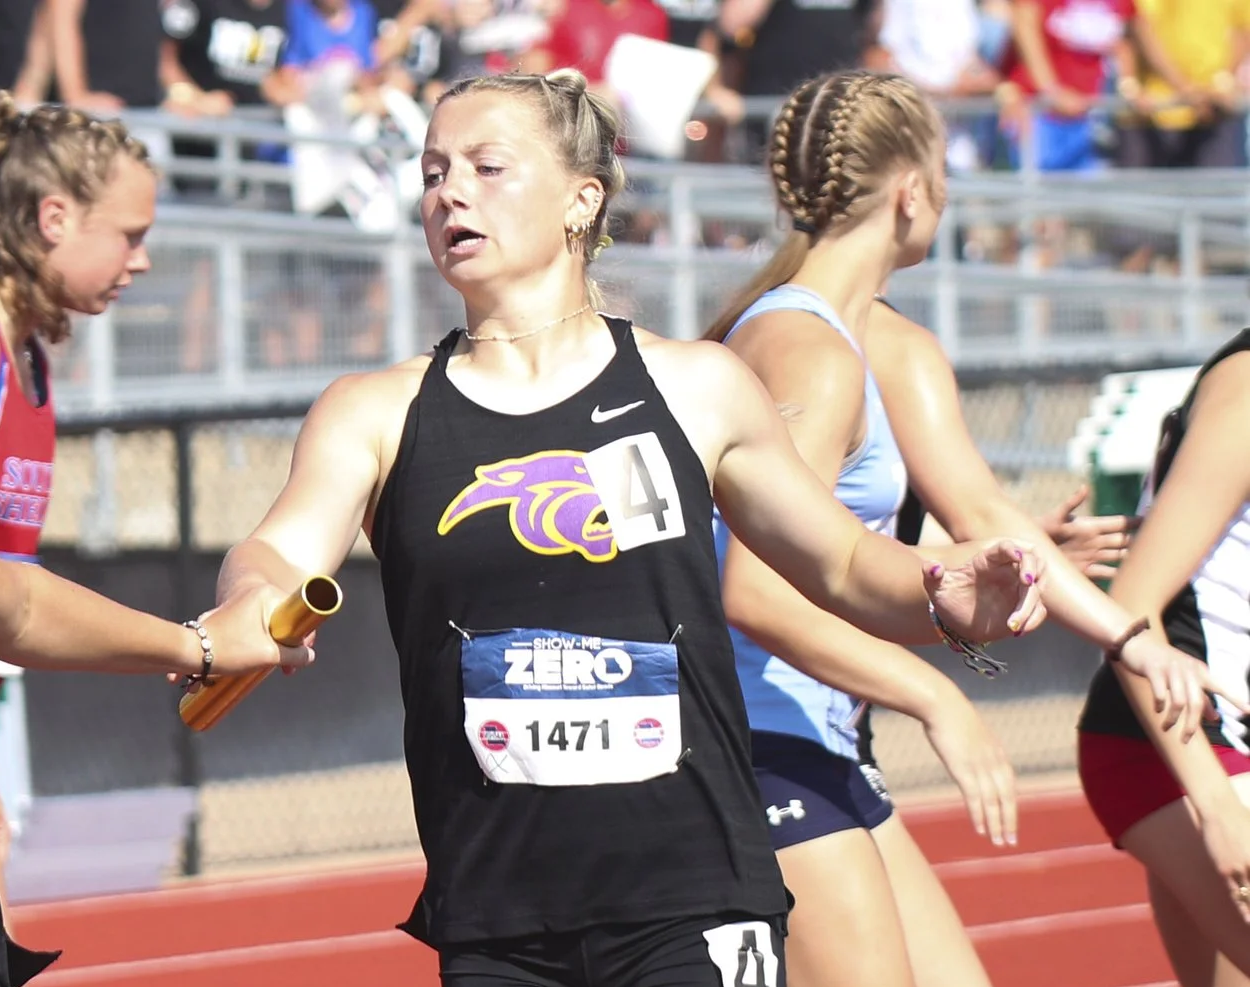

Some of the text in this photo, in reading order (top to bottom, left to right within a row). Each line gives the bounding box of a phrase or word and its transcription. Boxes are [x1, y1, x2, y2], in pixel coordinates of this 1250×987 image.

[620, 443, 669, 532] 4
[533, 637, 602, 650] SHOW-ME
[505, 648, 632, 684] ZERO
[525, 719, 610, 752] 1471
